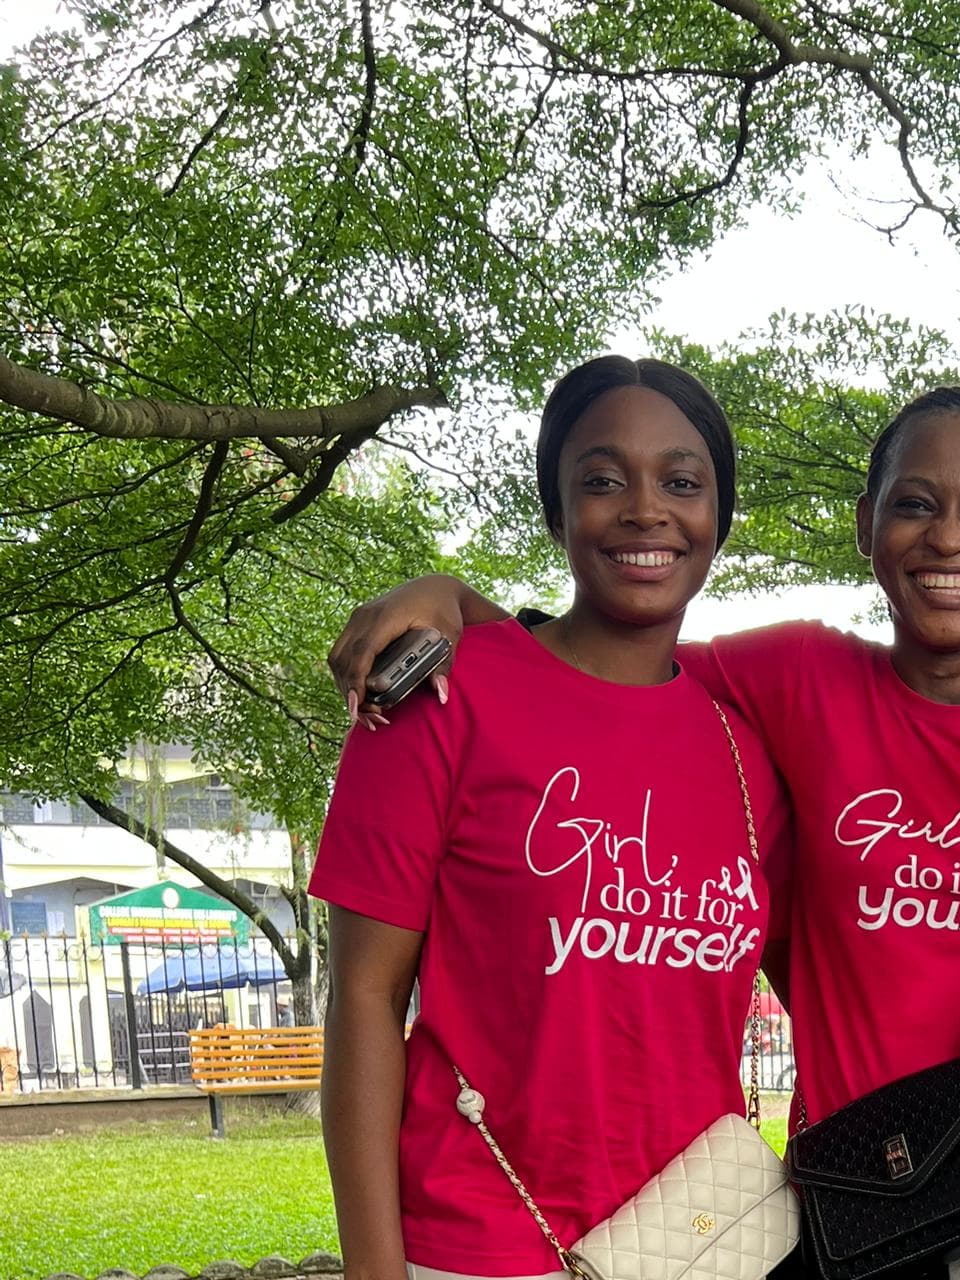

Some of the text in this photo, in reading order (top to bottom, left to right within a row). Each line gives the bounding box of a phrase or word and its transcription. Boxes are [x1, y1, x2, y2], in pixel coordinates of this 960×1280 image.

[600, 867, 744, 928] do it for
[895, 854, 943, 890] do
[545, 917, 760, 975] yourself
